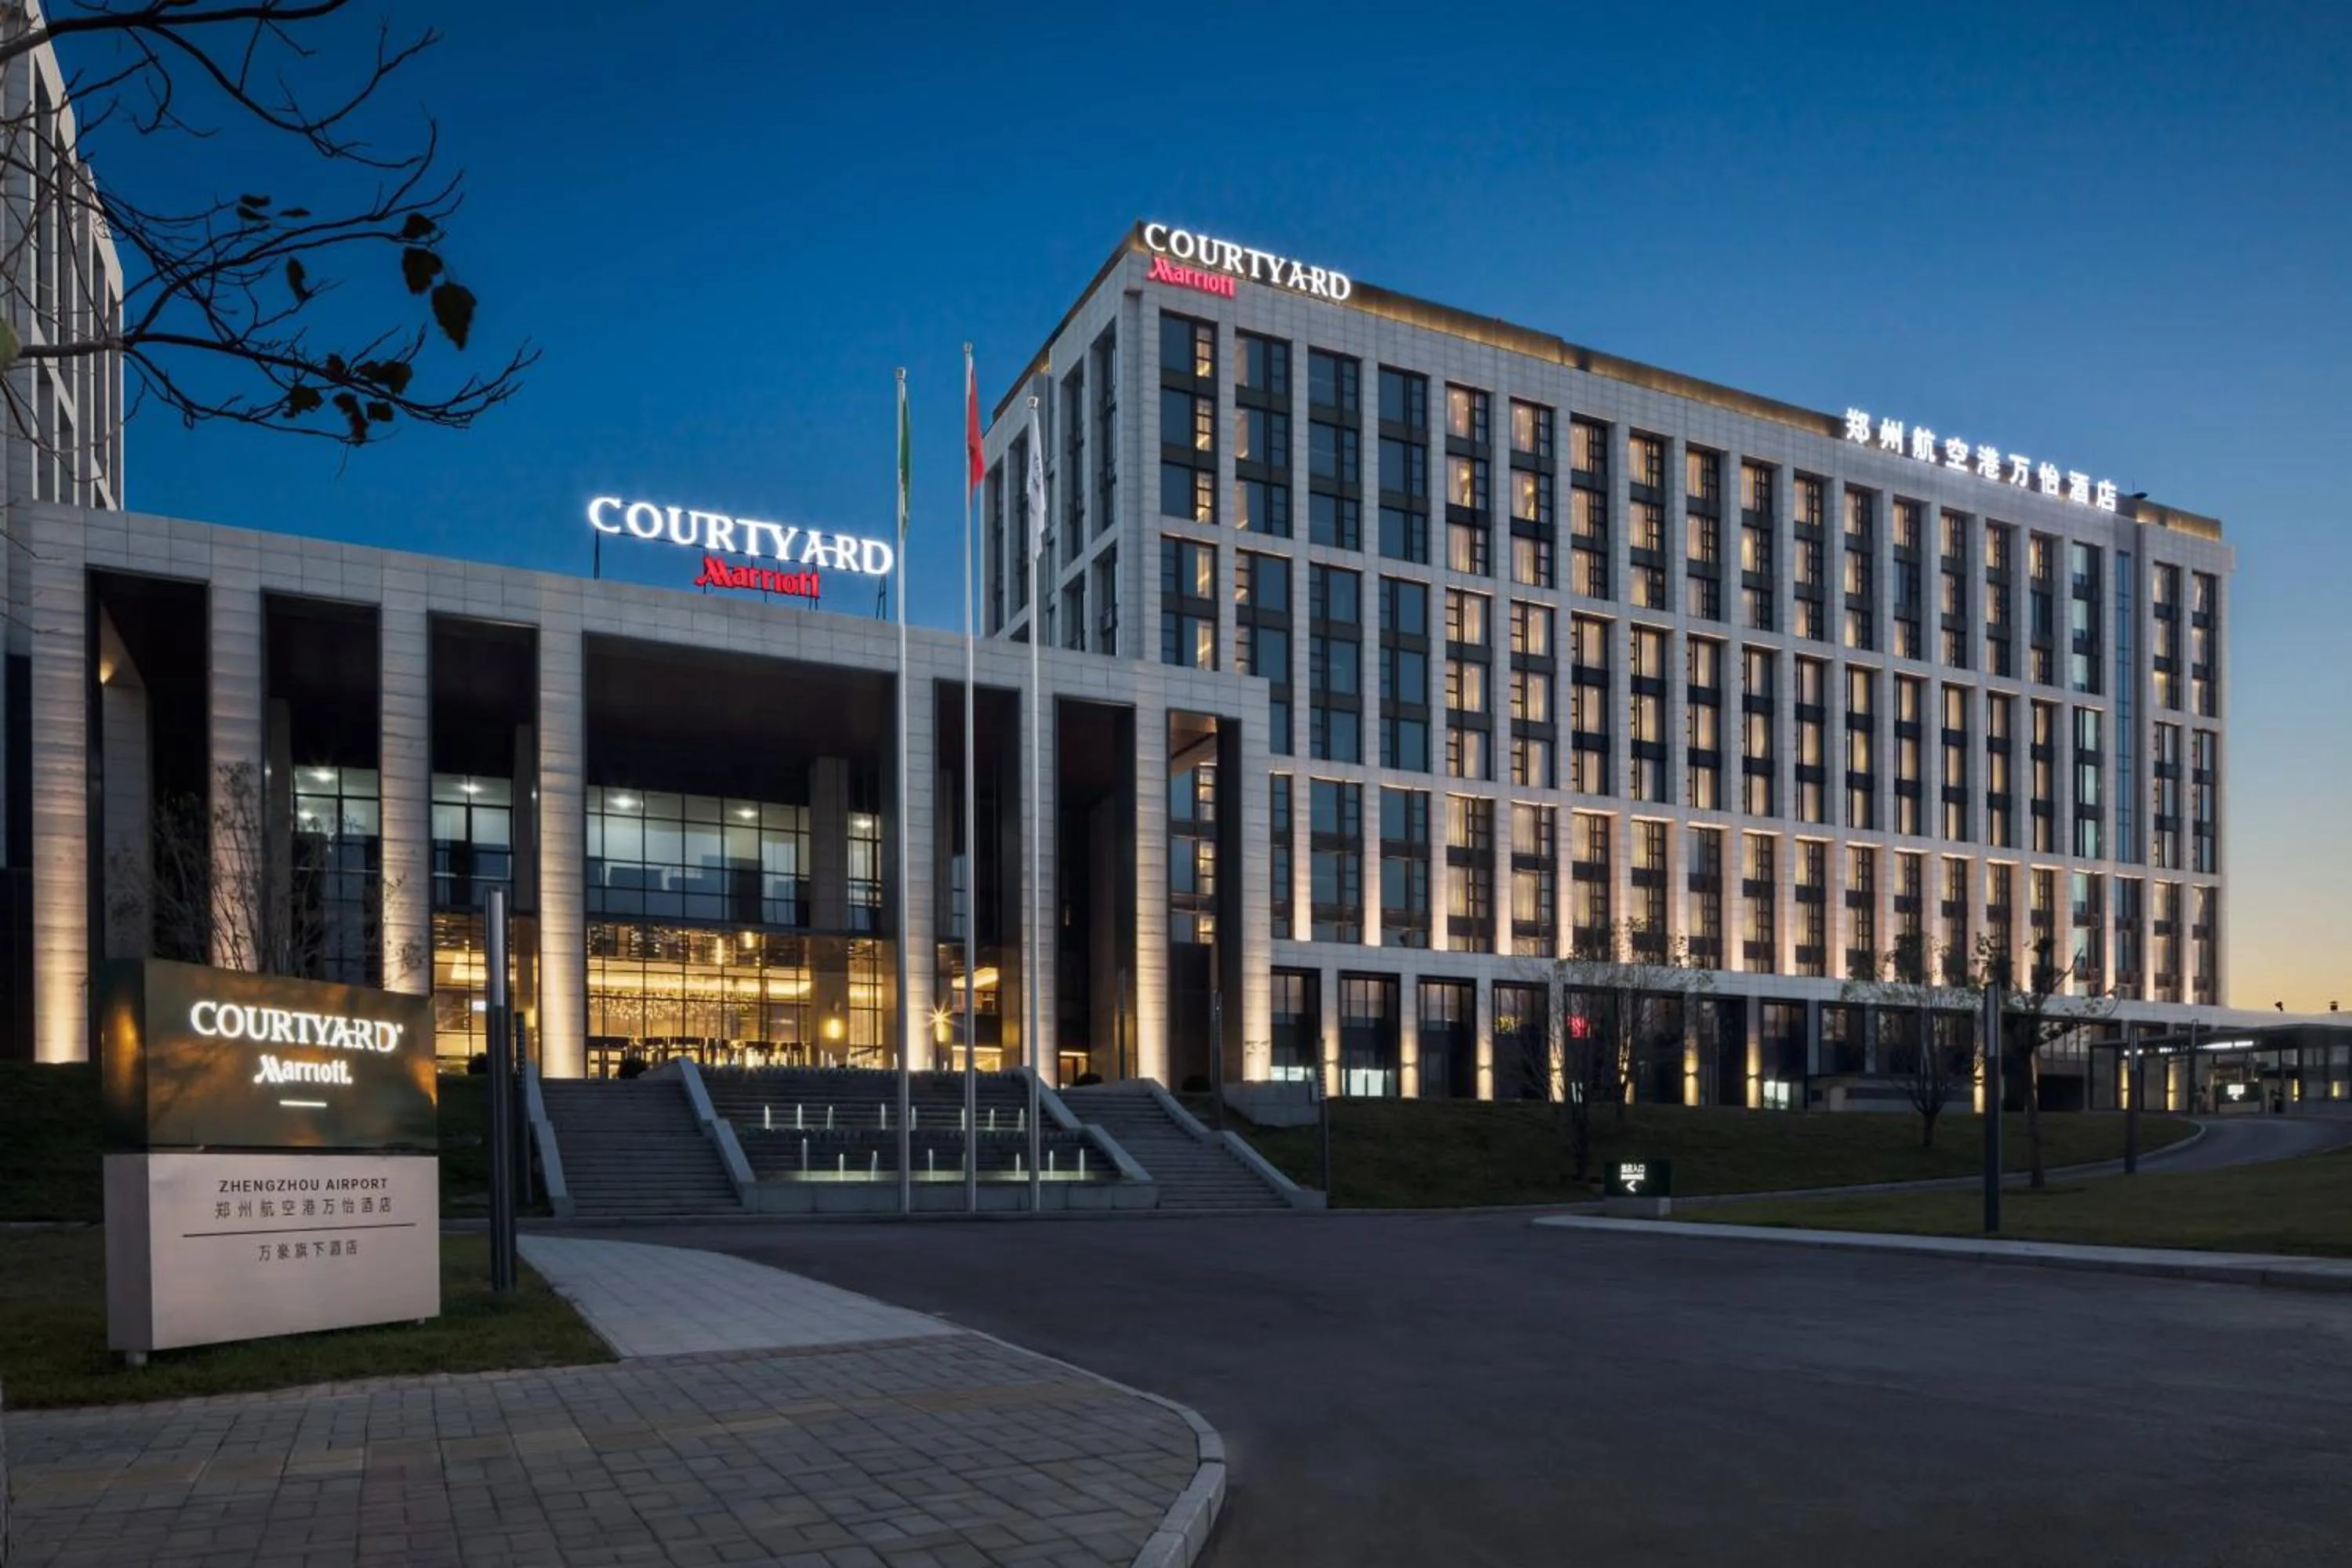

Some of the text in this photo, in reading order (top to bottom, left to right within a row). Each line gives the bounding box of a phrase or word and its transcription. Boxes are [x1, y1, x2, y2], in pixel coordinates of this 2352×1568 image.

[1144, 223, 1351, 300] COURTYARD
[1147, 256, 1236, 297] Marriott
[1845, 407, 2118, 512] 郑州航空港万怡酒店
[589, 496, 894, 575] COURTYARD
[695, 557, 821, 599] Marriott
[219, 1178, 388, 1192] ZHENGZHOU AIRPORT
[215, 1196, 390, 1219] 郑州航空港万怡酒店
[257, 1240, 358, 1261] 万豪旗下酒店
